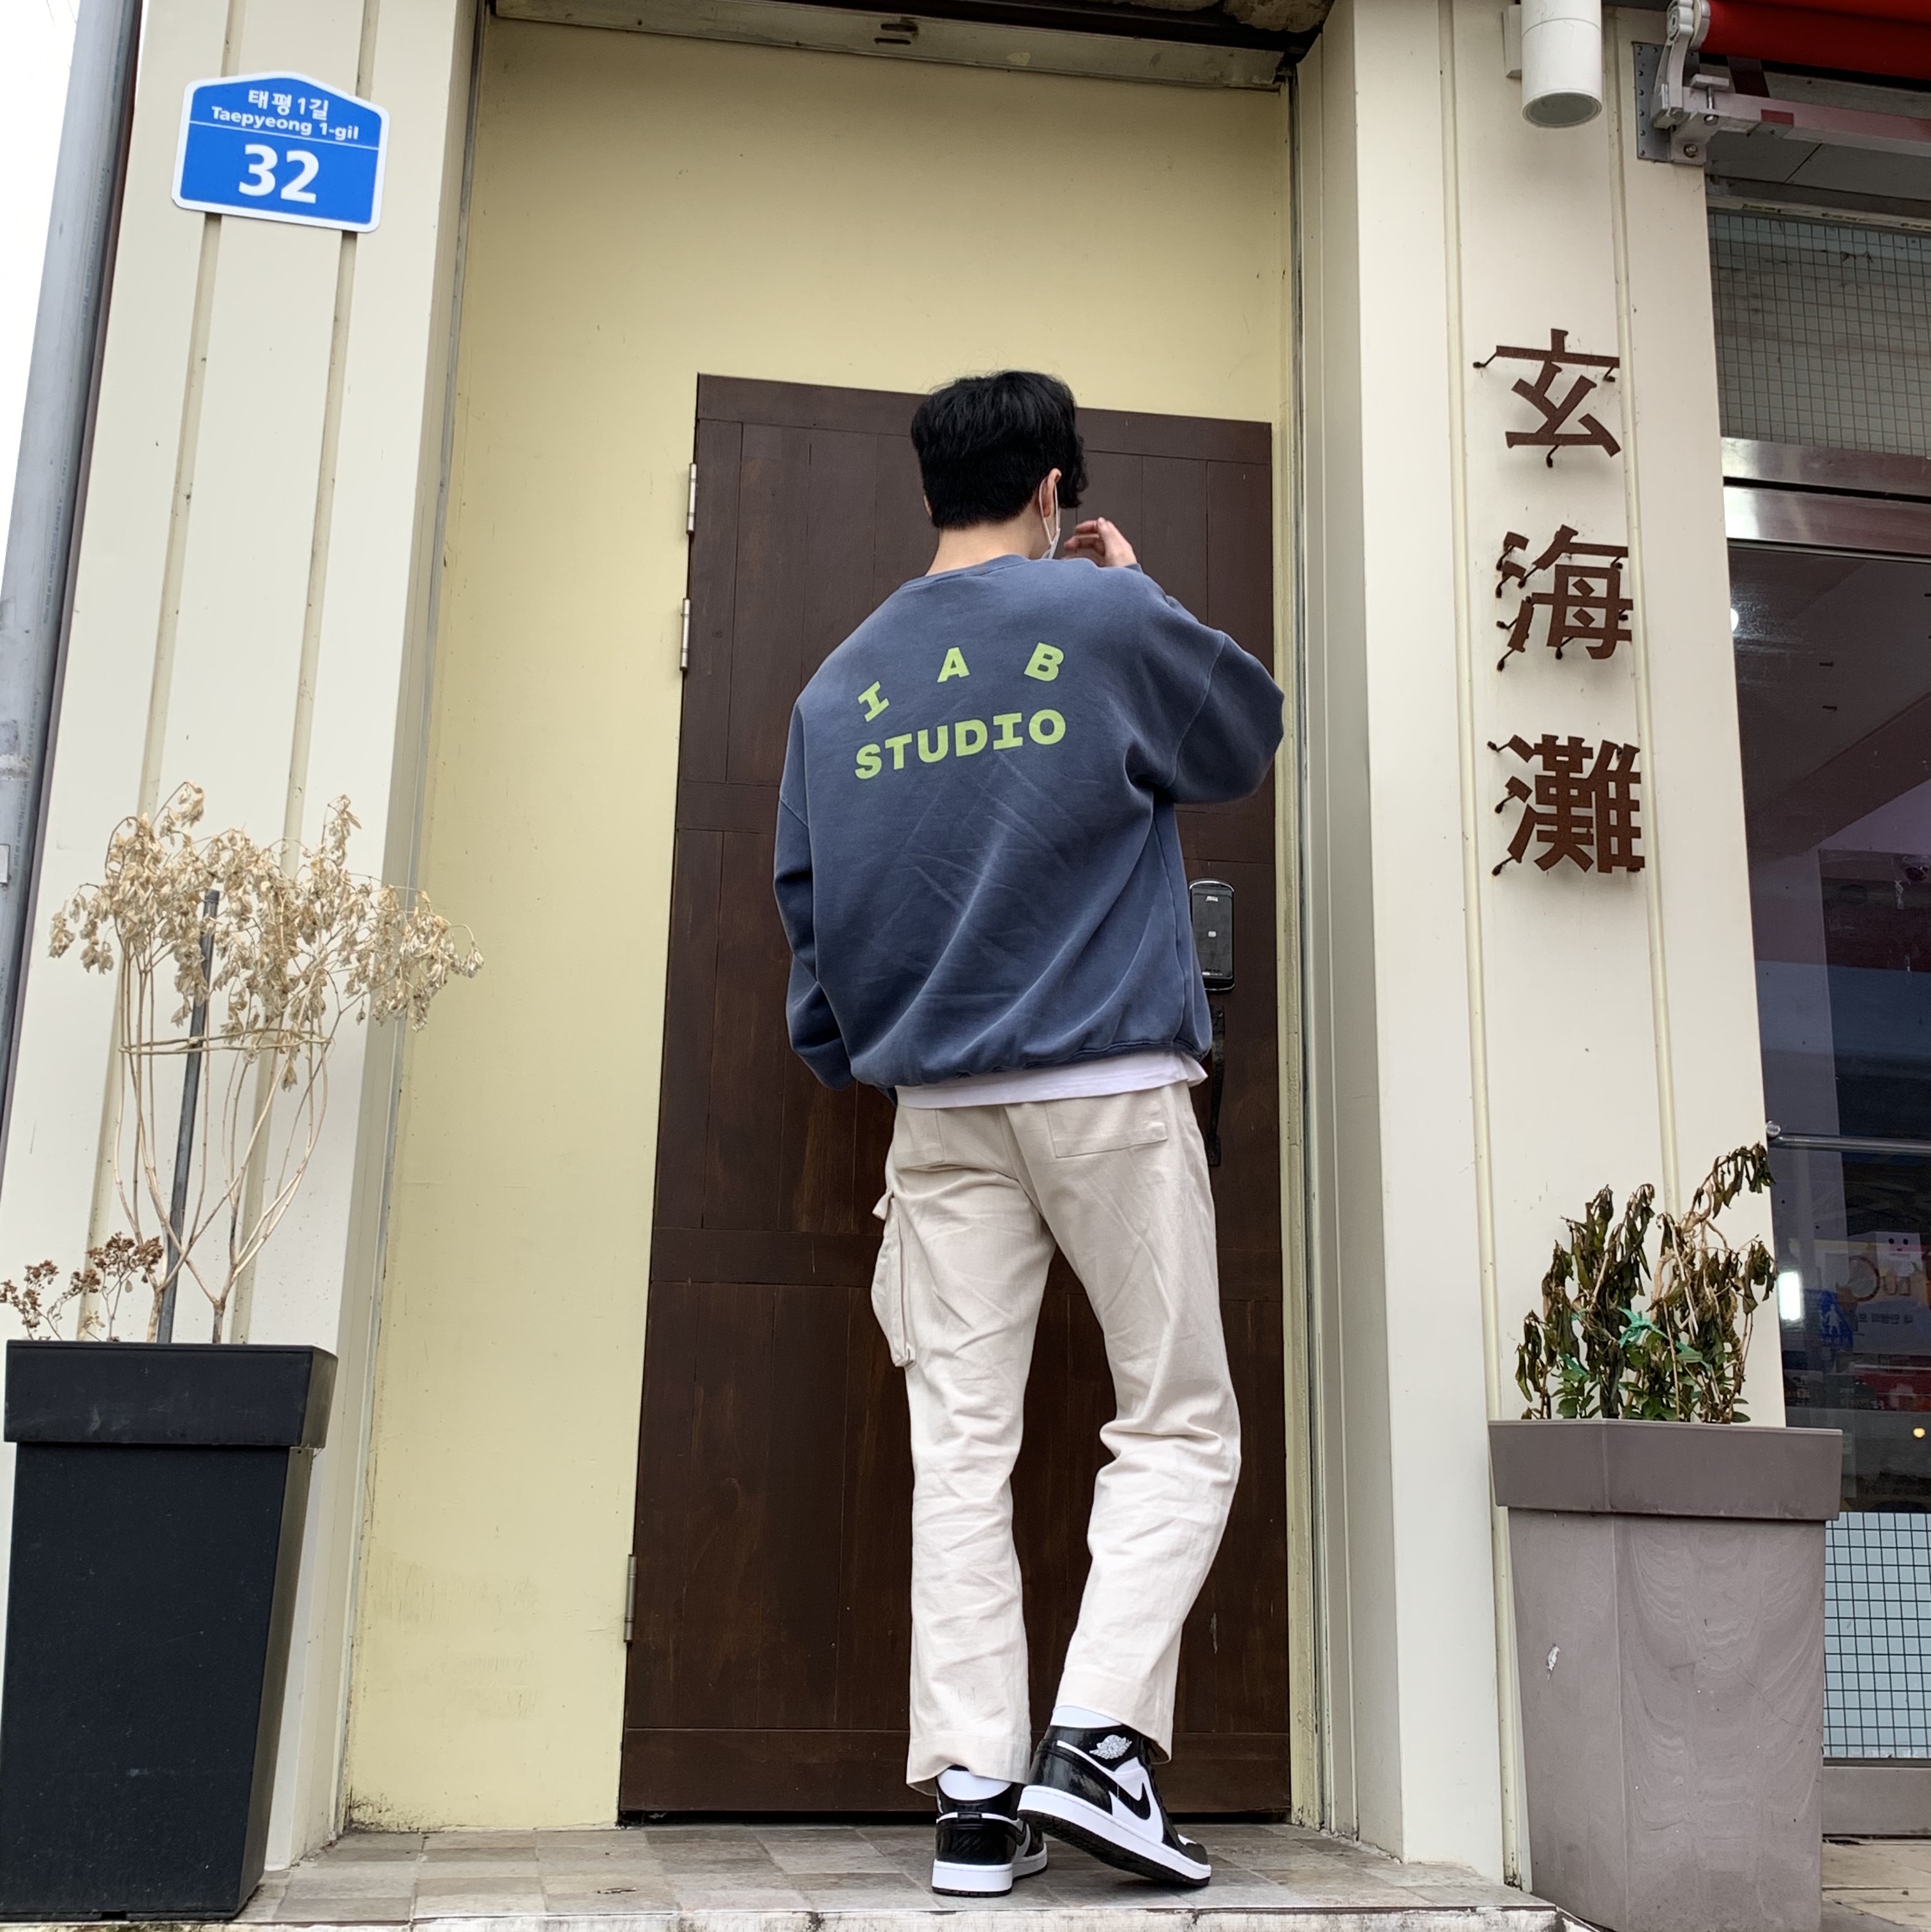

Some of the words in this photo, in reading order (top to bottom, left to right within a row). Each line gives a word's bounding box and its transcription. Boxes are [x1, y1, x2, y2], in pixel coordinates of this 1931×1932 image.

[211, 105, 312, 136] Taepyeong
[319, 122, 360, 141] 1-gil
[247, 89, 329, 121] 태평1길
[238, 143, 320, 204] 32
[854, 708, 1066, 780] STUDIO
